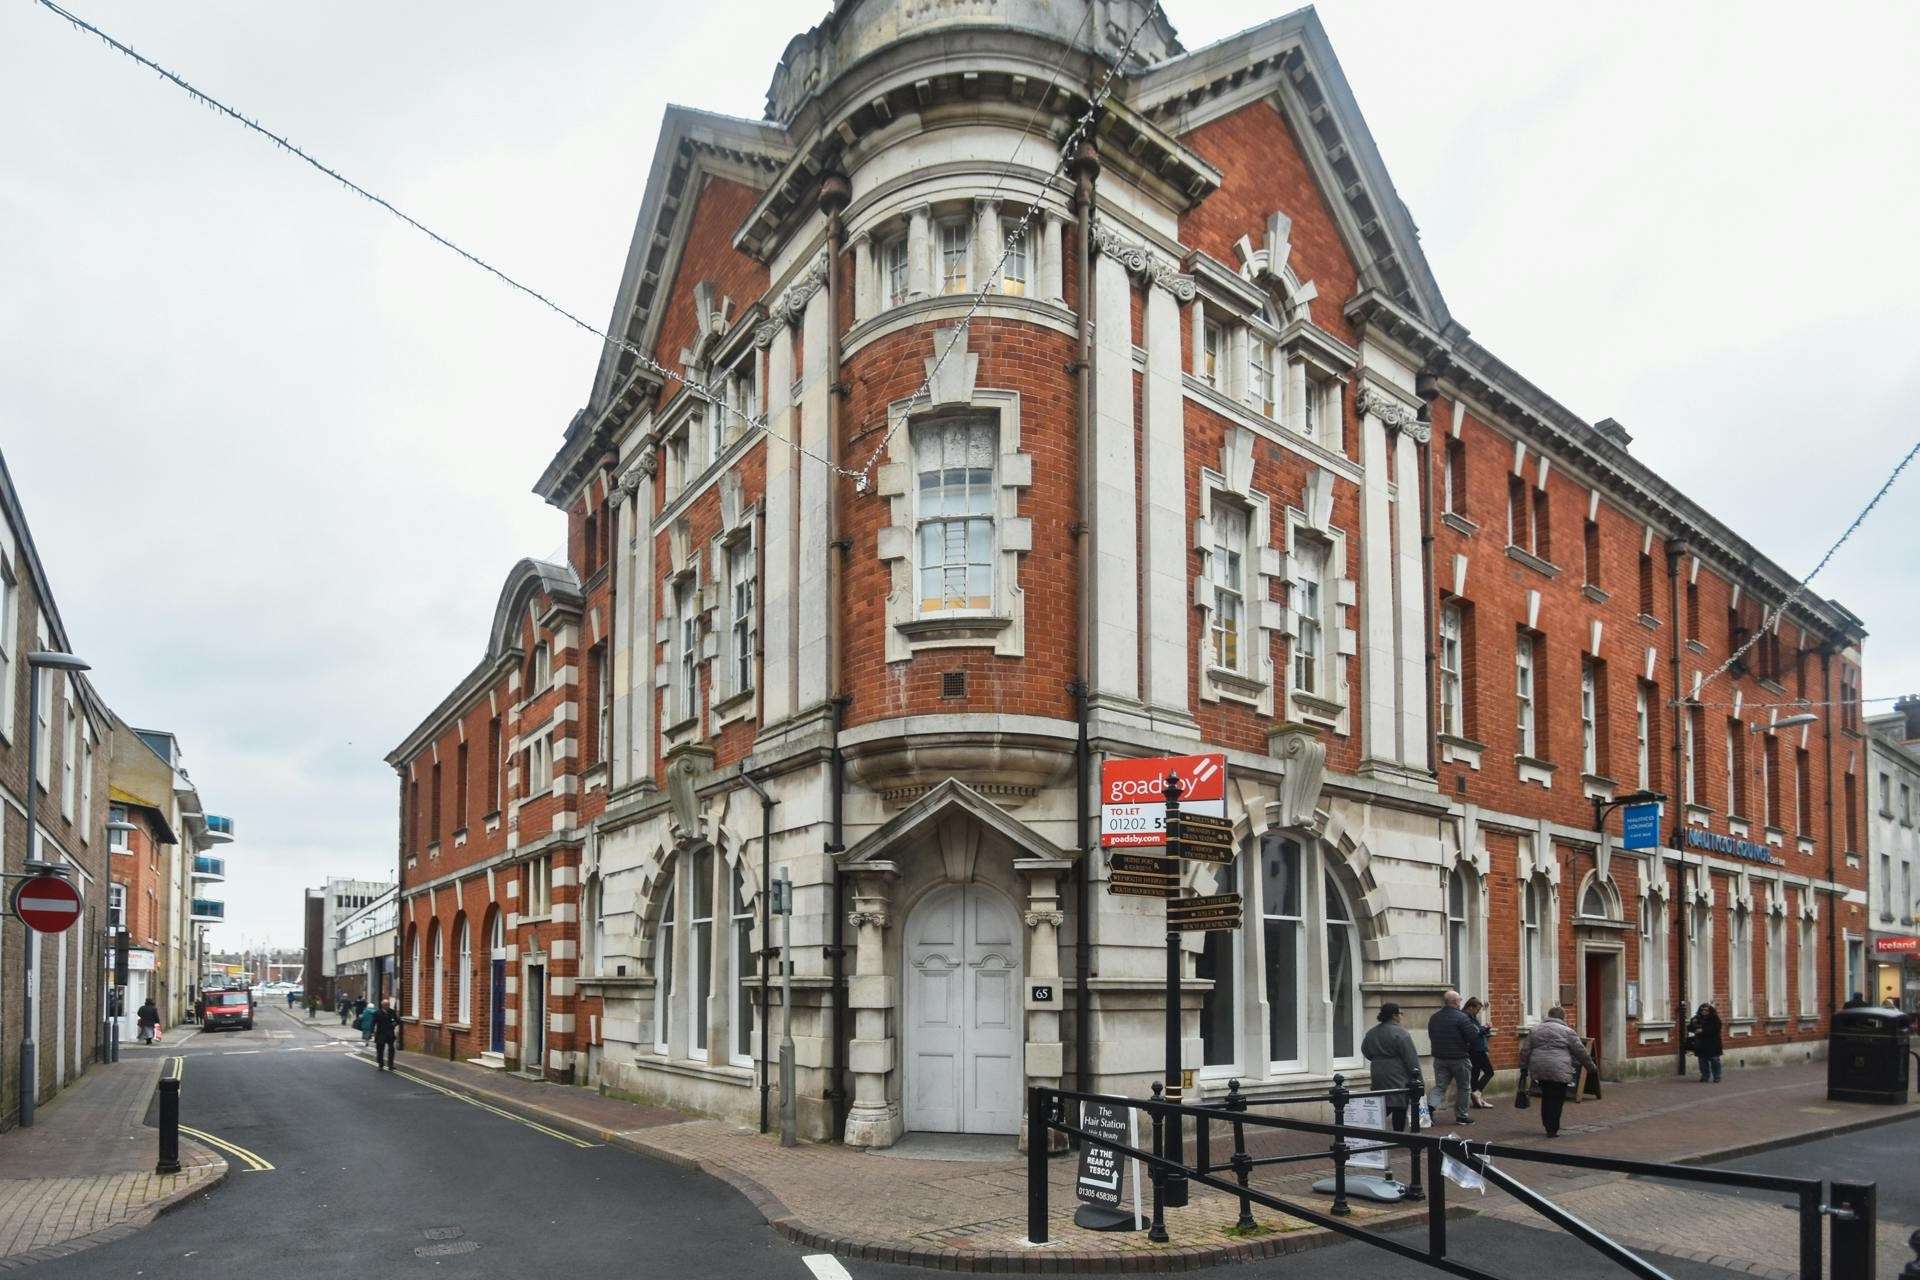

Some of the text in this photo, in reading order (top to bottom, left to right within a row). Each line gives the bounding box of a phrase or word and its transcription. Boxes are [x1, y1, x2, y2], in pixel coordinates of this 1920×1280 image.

[1110, 807, 1141, 816] TO LET
[1110, 817, 1146, 831] 01202
[1110, 834, 1160, 845] goadsby.com
[1878, 940, 1917, 950] Iceland
[1036, 989, 1048, 999] 65
[1098, 1106, 1113, 1117] The
[1084, 1116, 1126, 1130] Hair Station
[1103, 1131, 1119, 1140] Beauty
[1090, 1148, 1113, 1159] AT THE
[1086, 1156, 1115, 1168] REAR OF
[1089, 1166, 1111, 1177] TESCO
[1078, 1187, 1118, 1203] 01305 458398
